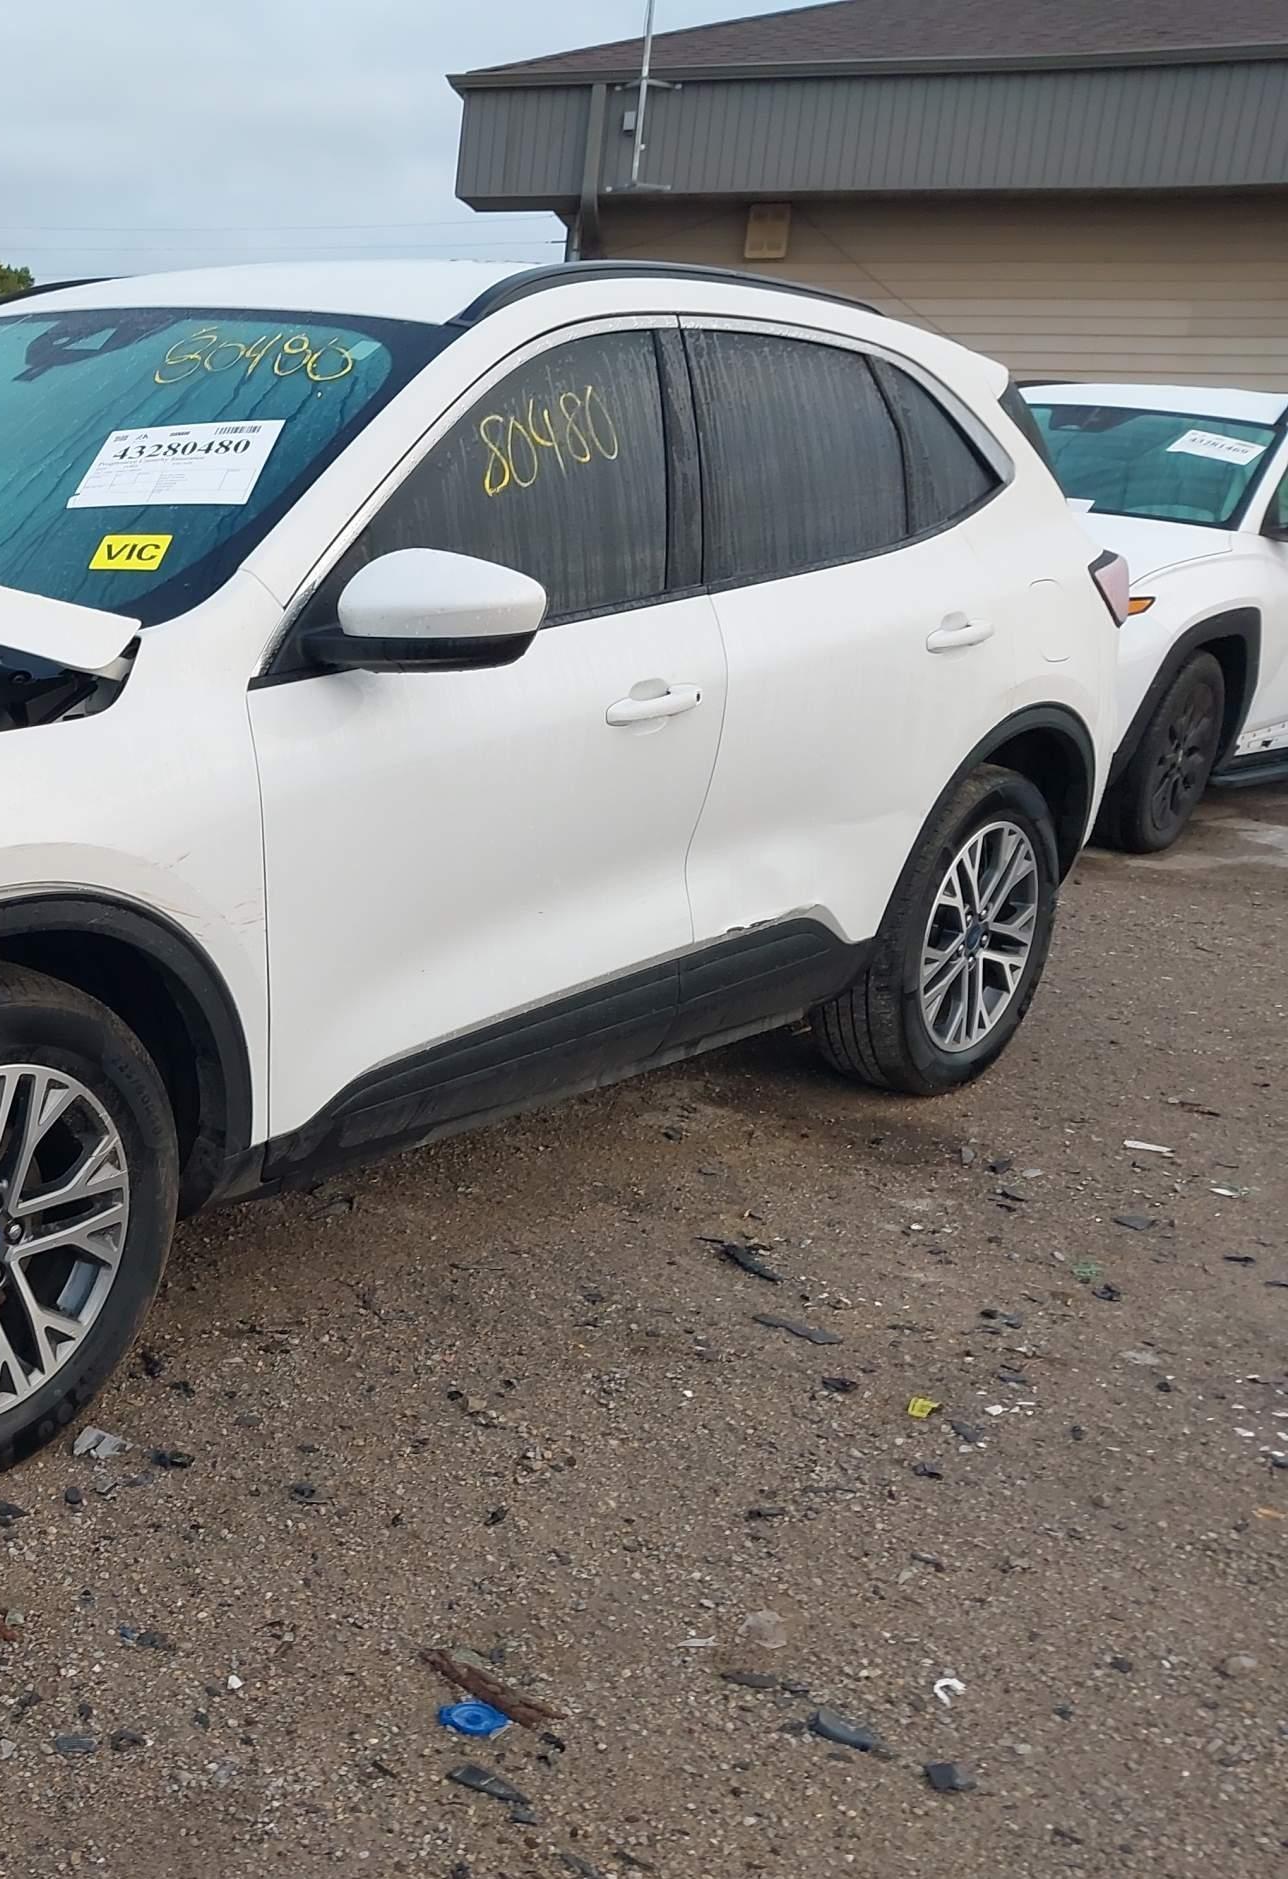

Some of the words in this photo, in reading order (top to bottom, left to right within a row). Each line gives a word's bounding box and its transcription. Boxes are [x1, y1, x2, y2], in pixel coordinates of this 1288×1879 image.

[113, 438, 251, 461] 43280480
[480, 385, 619, 496] 80480
[107, 543, 161, 561] VIC
